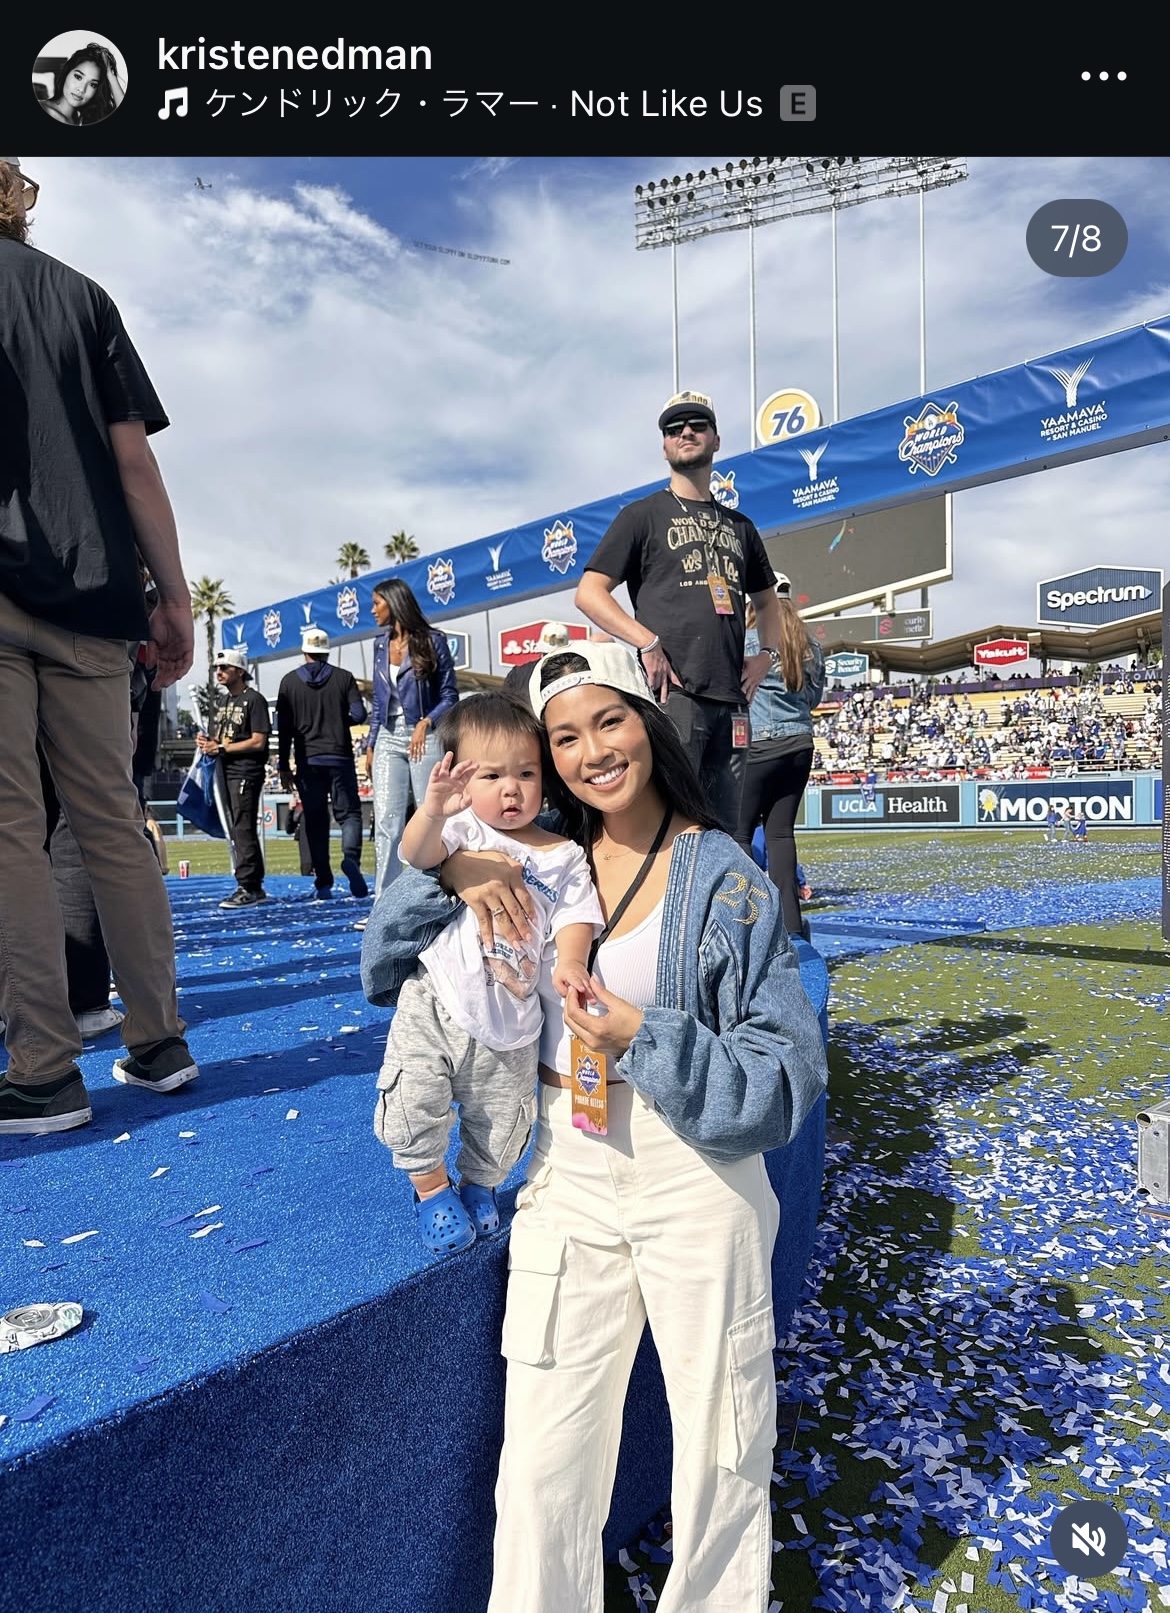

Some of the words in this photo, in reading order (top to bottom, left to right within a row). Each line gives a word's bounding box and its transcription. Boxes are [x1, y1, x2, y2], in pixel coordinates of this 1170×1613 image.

[772, 406, 805, 437] 76
[1040, 423, 1070, 438] RESORT
[1078, 413, 1108, 427] CASINO
[1052, 431, 1068, 441] SAN
[1069, 423, 1102, 437] MANUEL
[903, 432, 962, 459] Champions
[915, 426, 947, 443] WORLD
[671, 516, 707, 528] WORD
[1047, 585, 1146, 612] Spectrum
[839, 799, 877, 813] UCLA
[887, 796, 948, 814] Health
[1000, 795, 1132, 821] MORTON
[715, 872, 769, 925] 25
